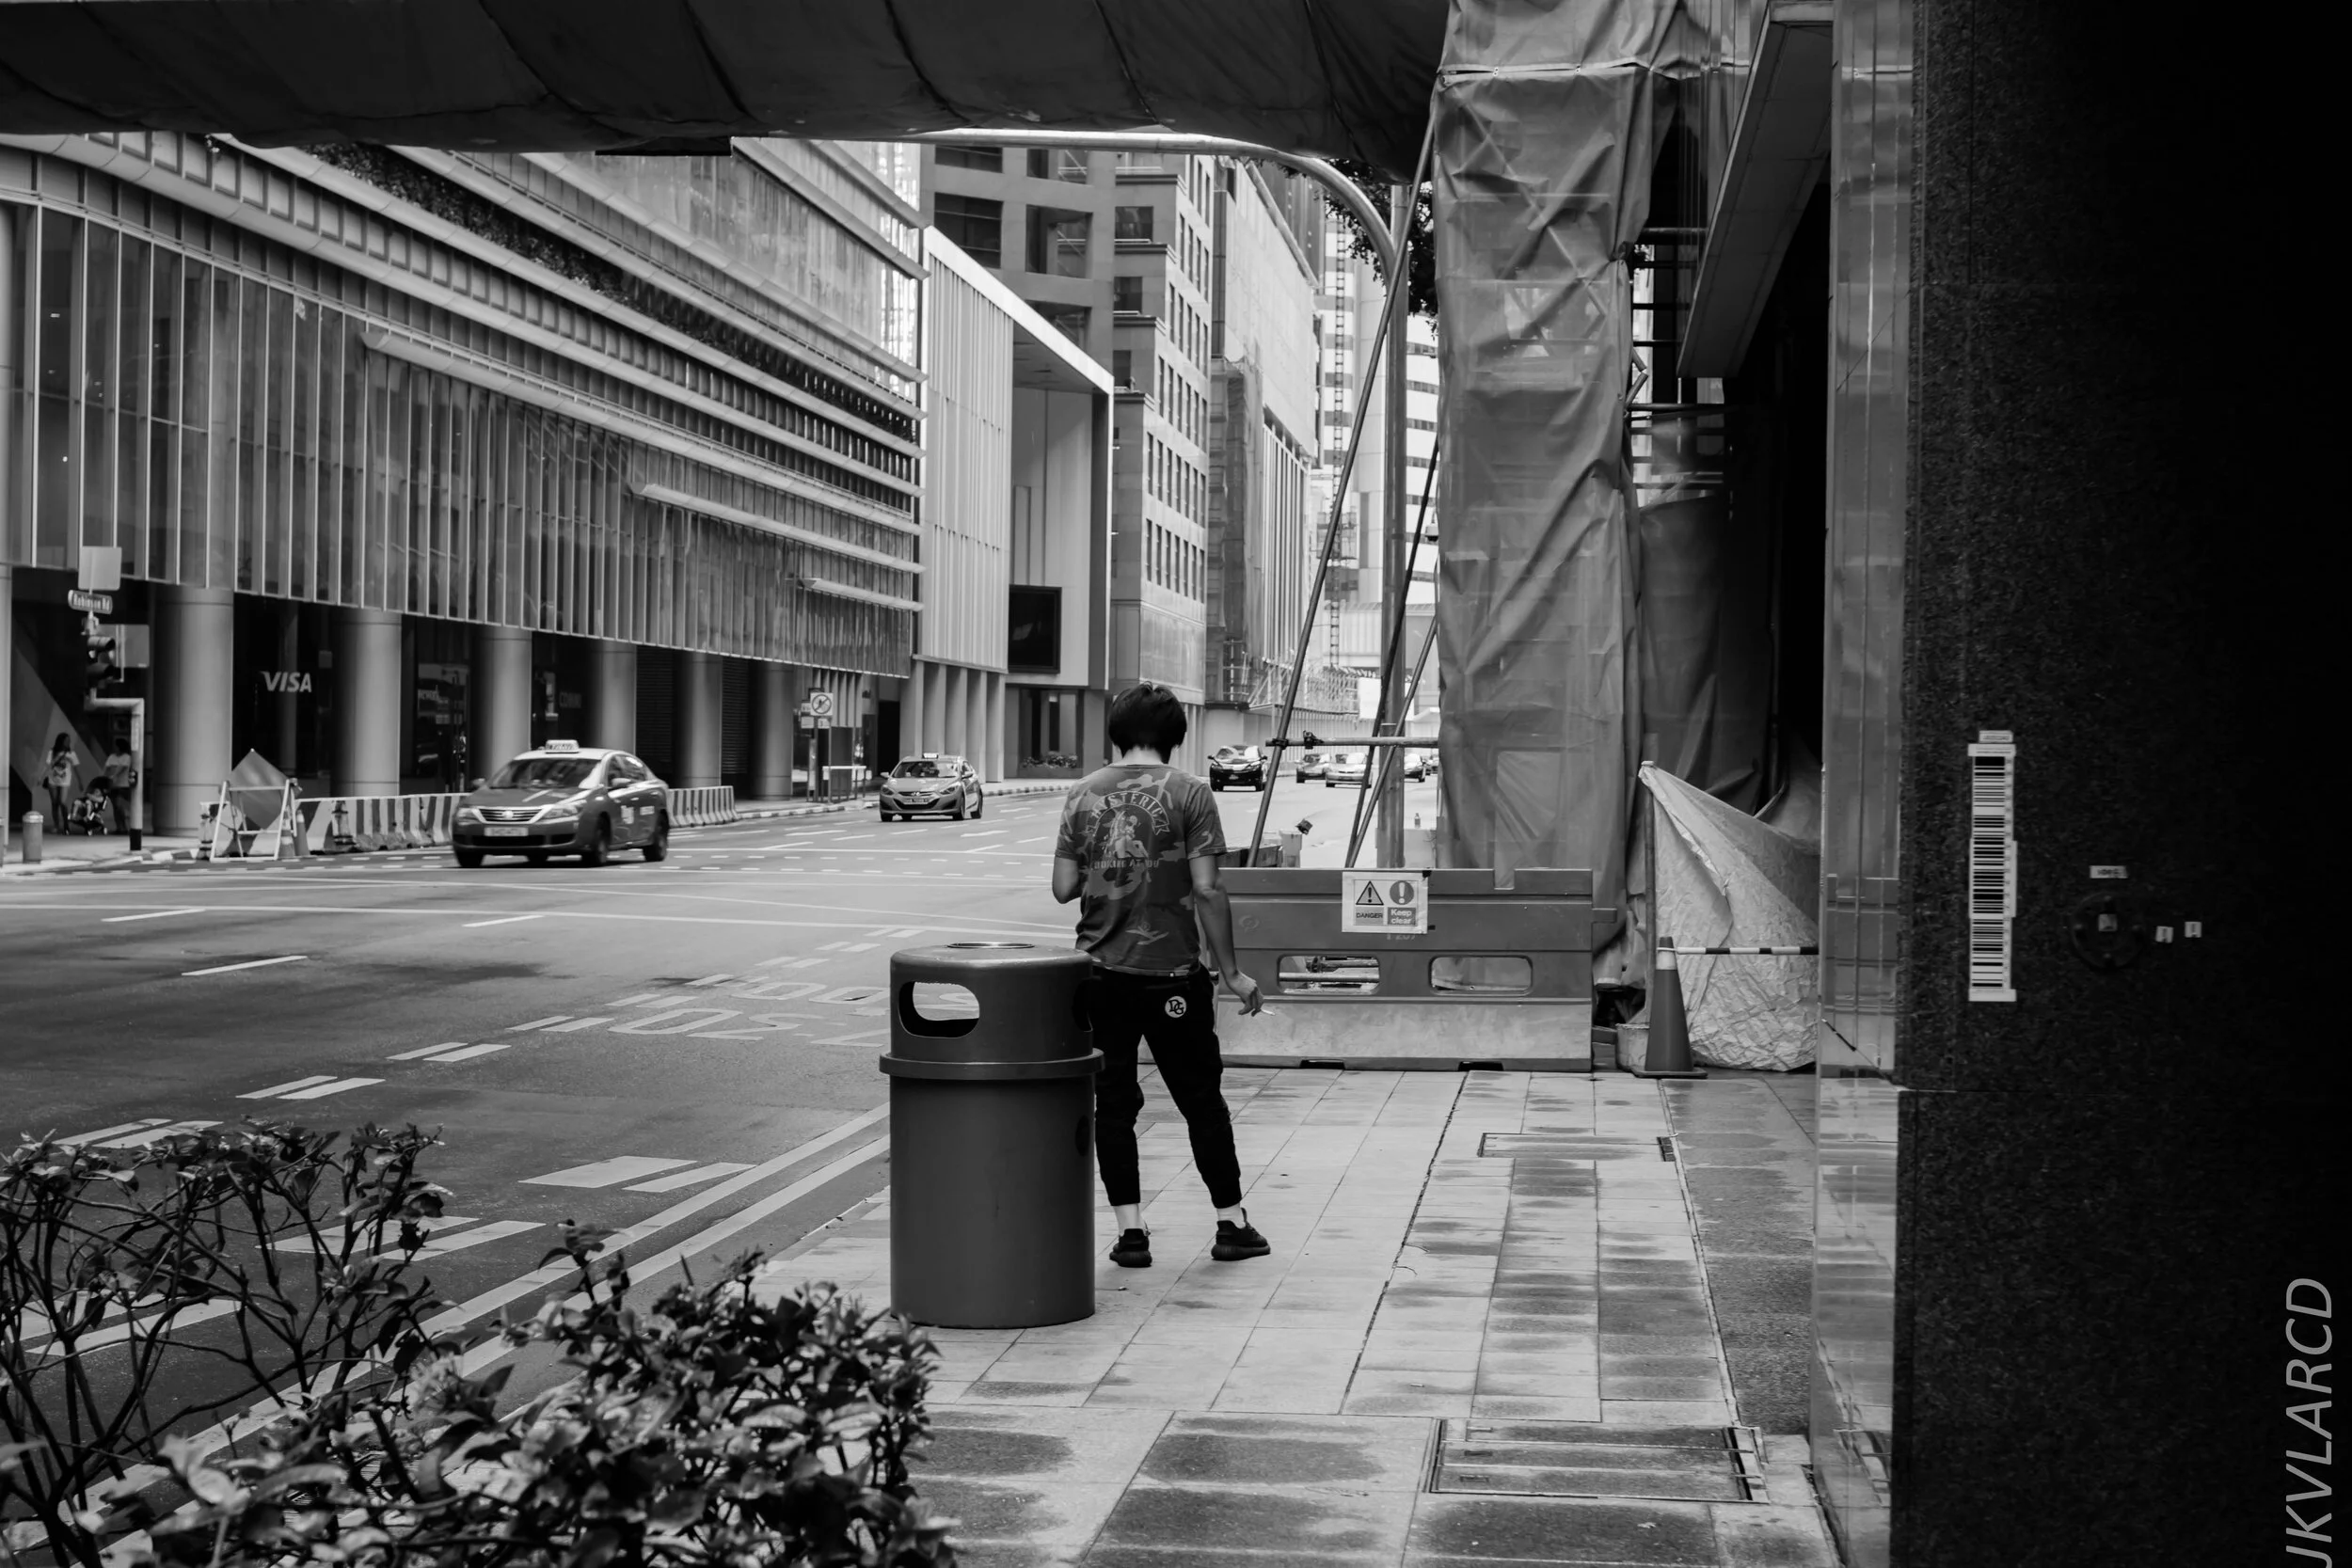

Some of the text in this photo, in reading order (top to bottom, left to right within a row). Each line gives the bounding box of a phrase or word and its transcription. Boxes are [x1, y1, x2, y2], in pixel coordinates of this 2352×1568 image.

[72, 593, 102, 610] Robinson
[259, 671, 312, 693] VISA
[1391, 909, 1412, 917] Keep
[1391, 916, 1412, 925] clear
